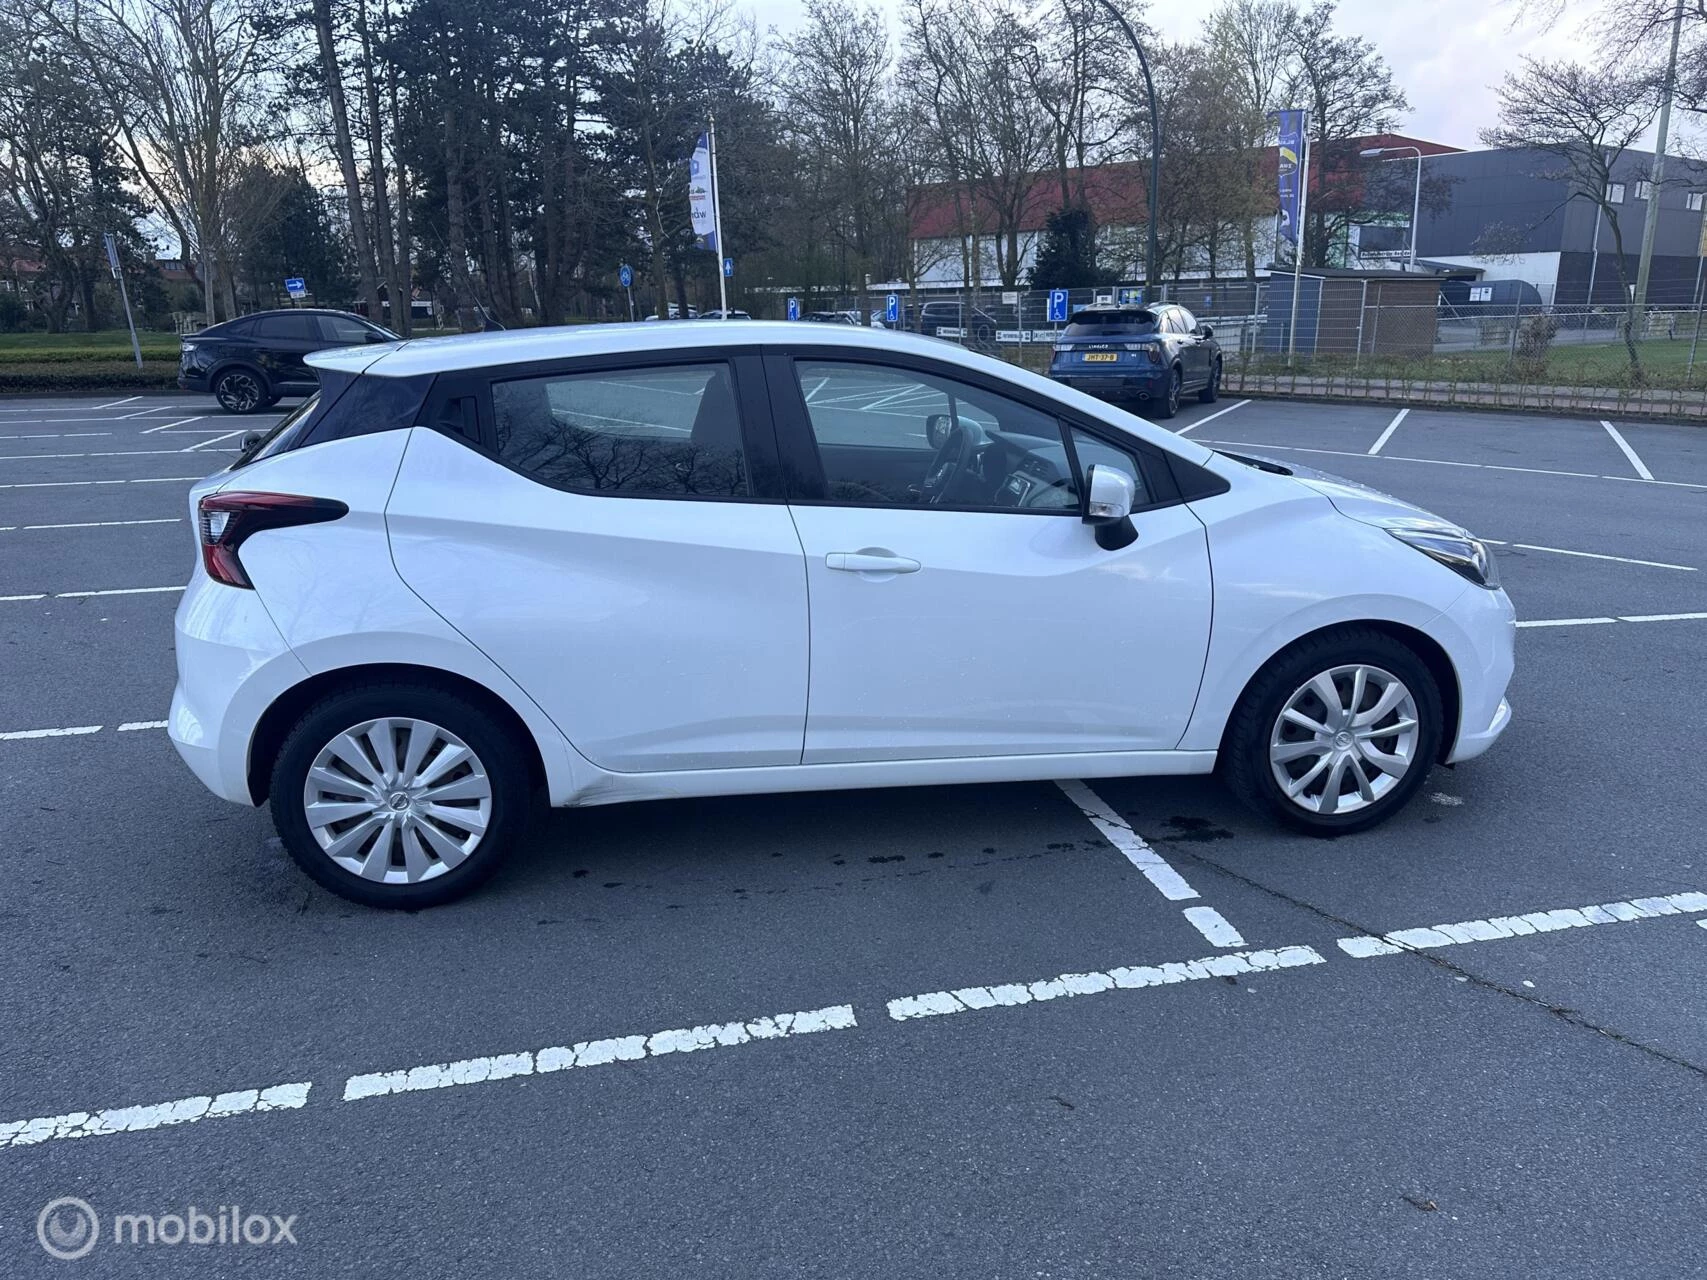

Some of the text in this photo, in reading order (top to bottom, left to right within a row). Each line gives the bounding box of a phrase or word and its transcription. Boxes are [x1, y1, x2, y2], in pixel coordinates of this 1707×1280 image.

[789, 300, 795, 311] P
[888, 296, 896, 310] P
[1053, 292, 1064, 308] P
